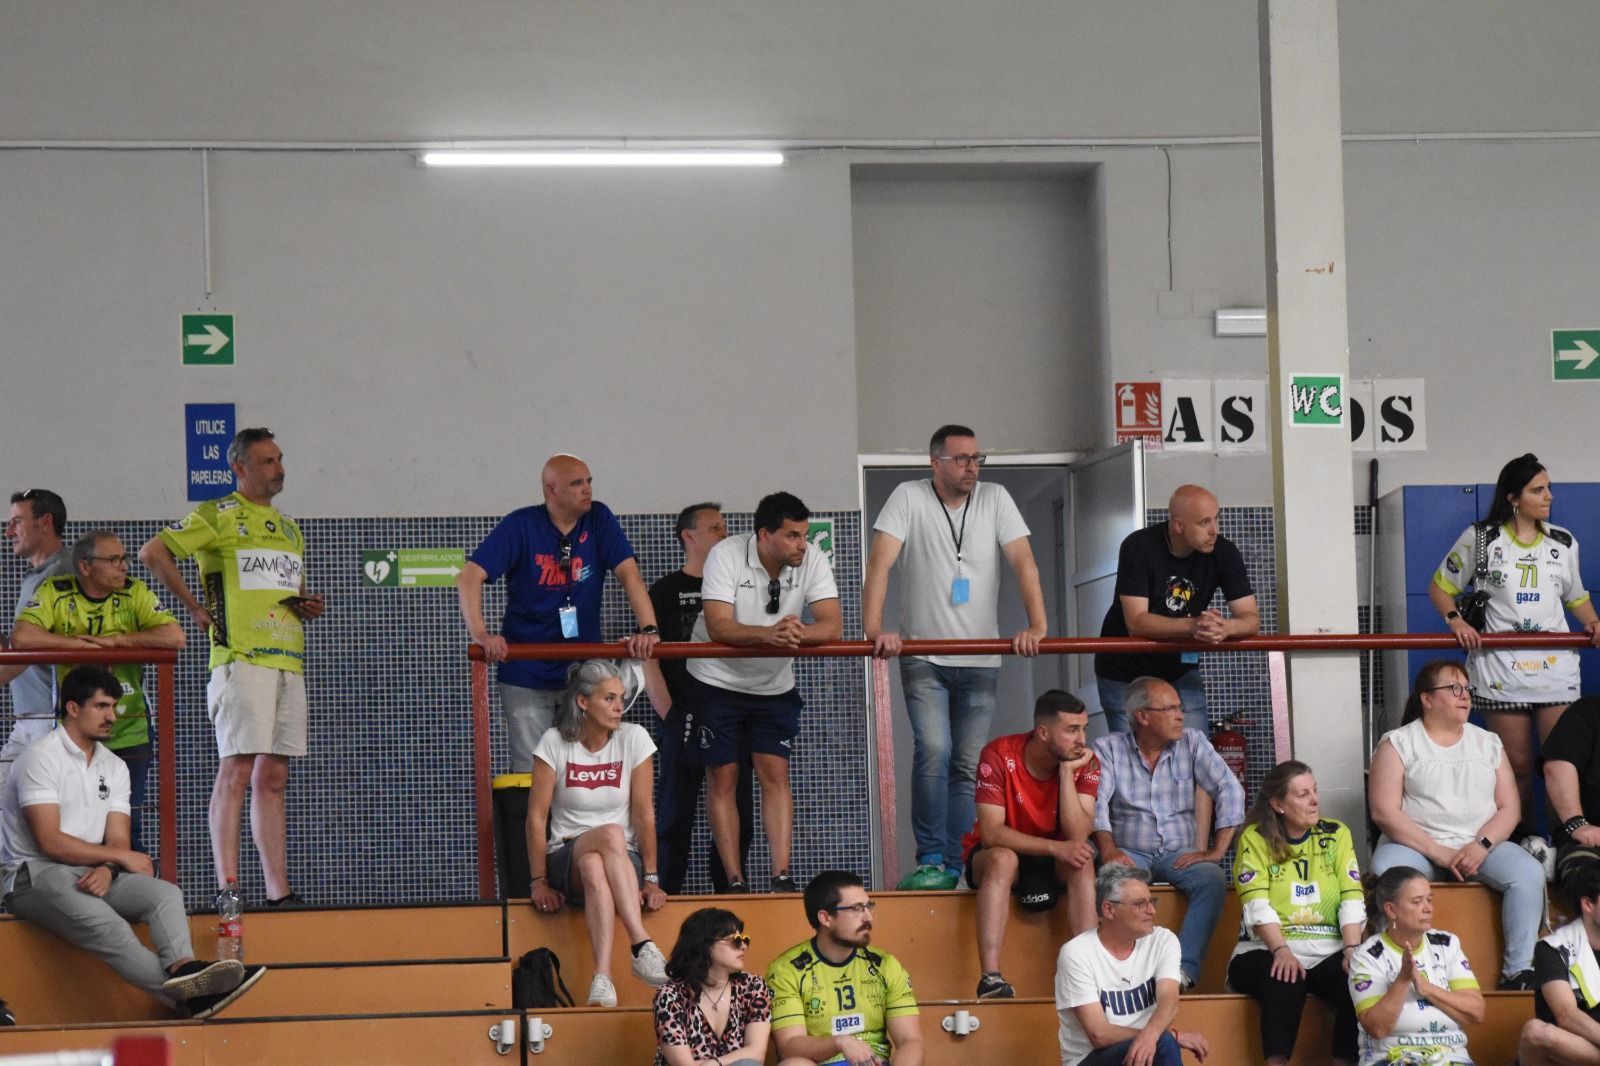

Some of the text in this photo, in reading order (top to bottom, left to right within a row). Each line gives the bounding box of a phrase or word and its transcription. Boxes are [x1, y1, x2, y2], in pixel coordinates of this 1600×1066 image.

[1290, 384, 1343, 417] WC
[195, 419, 227, 435] UTILICE
[202, 444, 220, 461] LAS
[190, 469, 233, 486] PAPELERAS
[1515, 562, 1538, 588] 71
[1516, 592, 1540, 605] gaza
[569, 769, 617, 782] Levi's
[1295, 884, 1316, 897] gaza
[834, 984, 856, 1011] 13
[835, 1016, 860, 1032] gaza
